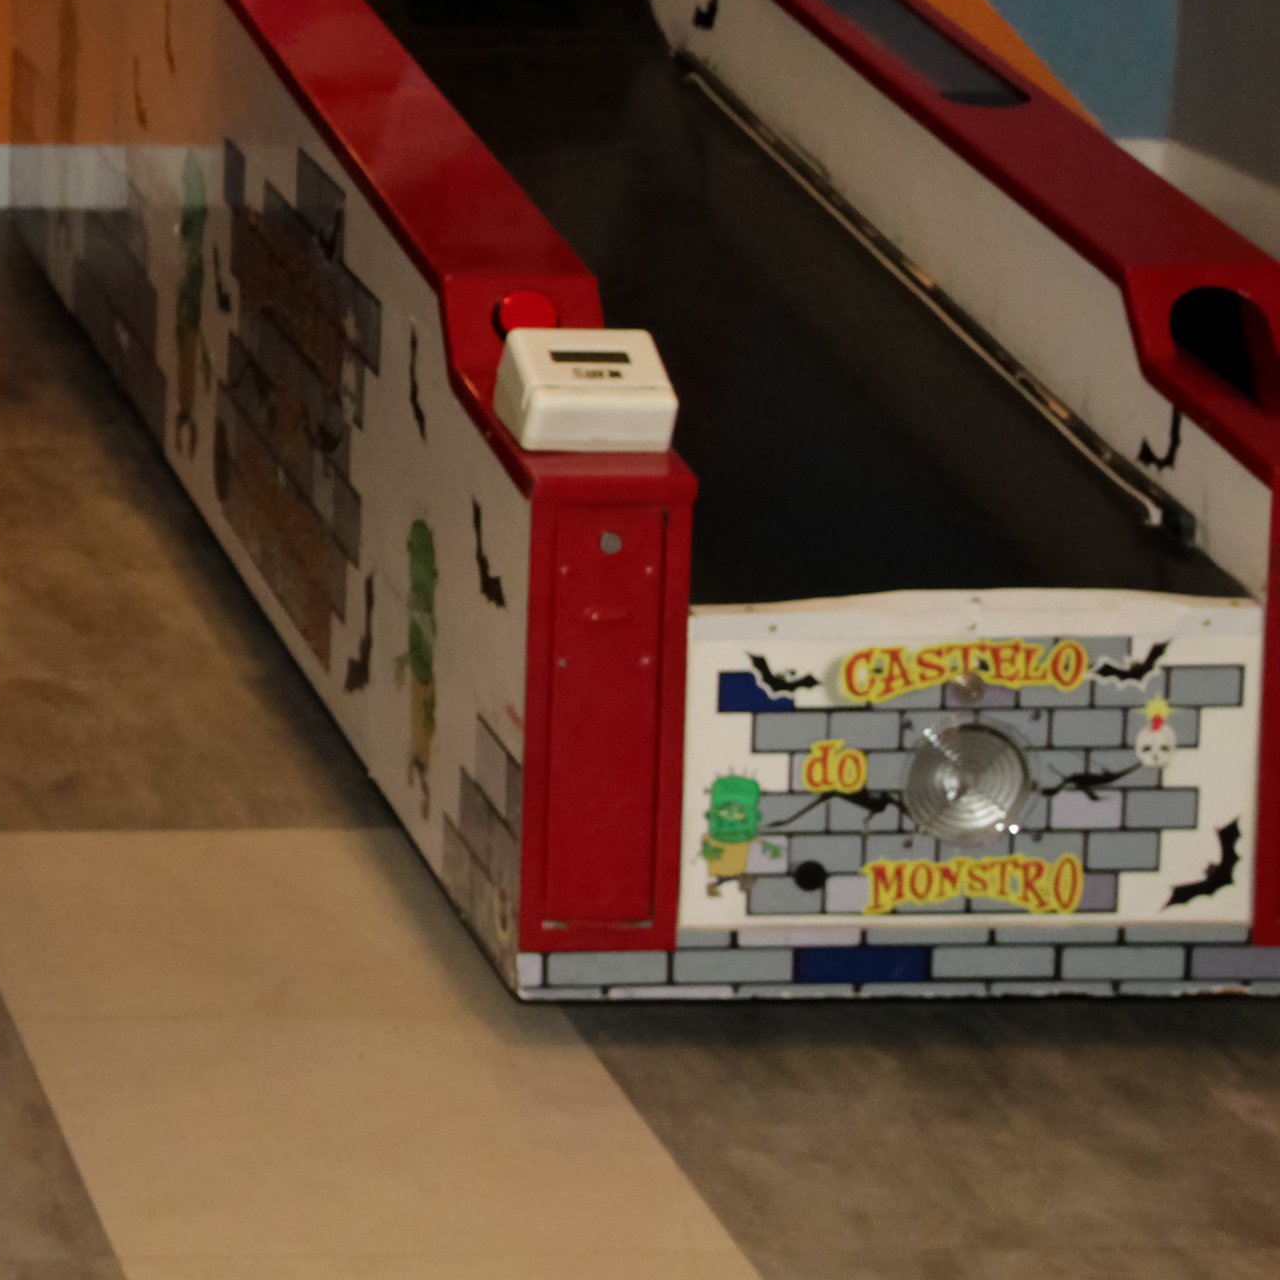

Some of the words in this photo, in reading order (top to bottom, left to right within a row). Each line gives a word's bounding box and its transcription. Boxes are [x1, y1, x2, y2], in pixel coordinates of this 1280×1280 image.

[843, 639, 1088, 702] CASTELO
[803, 741, 865, 791] do
[864, 854, 1082, 914] MONSTRO
